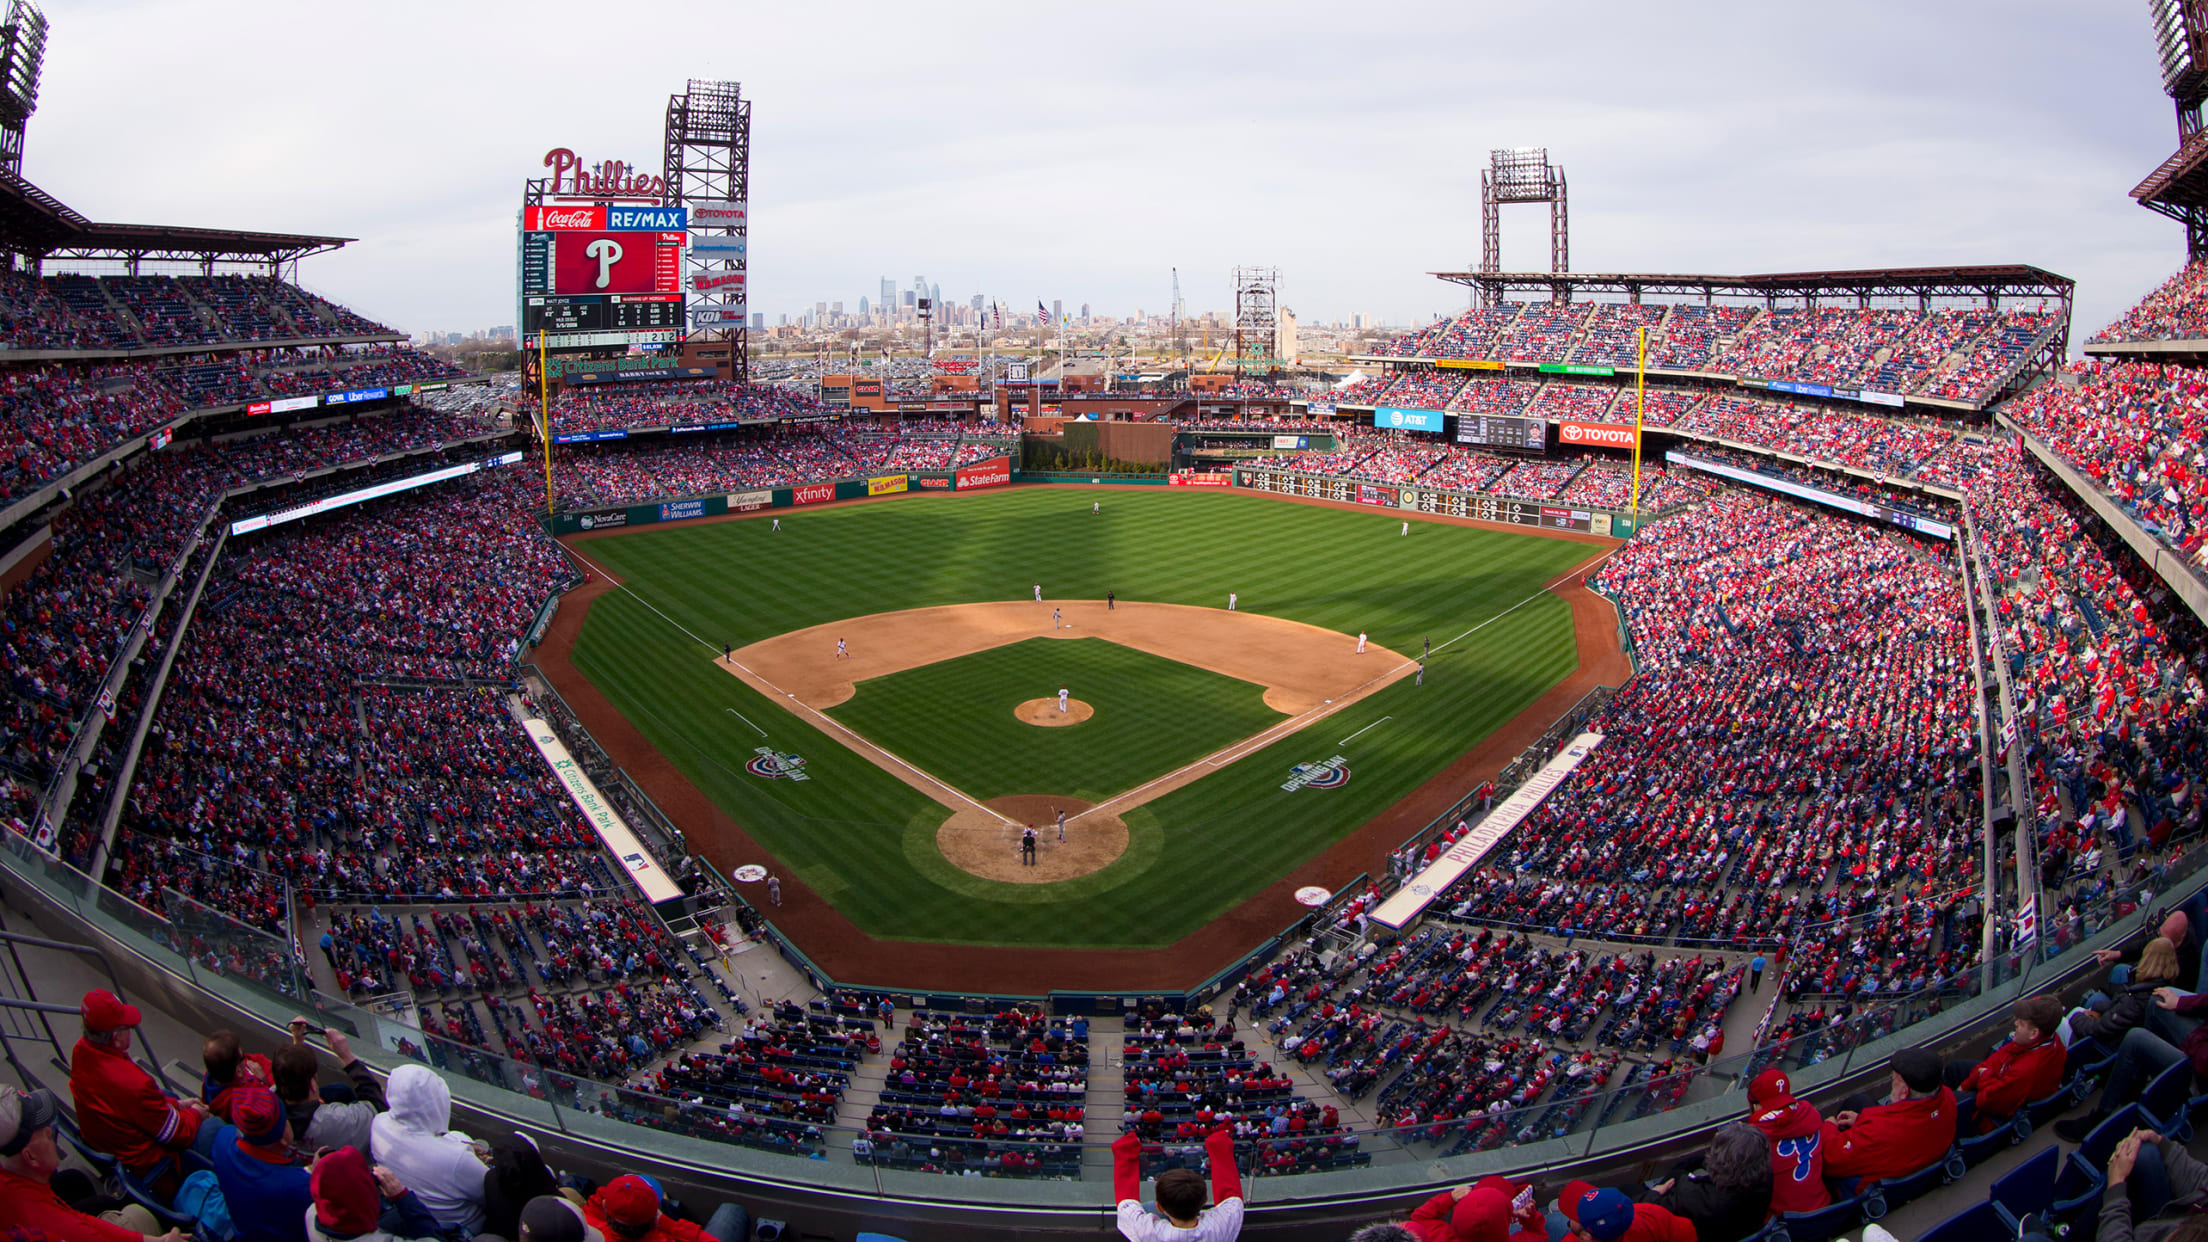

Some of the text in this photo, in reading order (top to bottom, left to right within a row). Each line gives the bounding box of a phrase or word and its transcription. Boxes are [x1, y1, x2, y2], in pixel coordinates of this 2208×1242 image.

[543, 148, 666, 196] Phillies
[546, 210, 595, 227] Coca-Cola
[611, 212, 681, 228] RE/MAX
[707, 209, 745, 219] TOYOTA
[586, 239, 623, 289] P
[652, 333, 658, 341] 2
[661, 332, 666, 341] 1
[669, 332, 675, 341] 2
[565, 354, 678, 374] Citizens Bank Park
[856, 385, 879, 393] GIANT
[1404, 414, 1428, 426] AT&T
[1584, 428, 1634, 444] TOYOTA
[920, 479, 949, 487] GIANT
[796, 487, 833, 503] xfinity
[671, 501, 702, 511] SHERWIN
[740, 503, 760, 512] LAGER
[593, 513, 627, 523] NovaCare
[1322, 755, 1348, 769] DAY
[784, 769, 811, 782] DAY
[1280, 765, 1330, 792] OPENING
[563, 769, 616, 829] Citizens Bank Park
[1446, 767, 1565, 864] PHILADELPHIA PHILLIES
[1776, 1079, 1784, 1093] P
